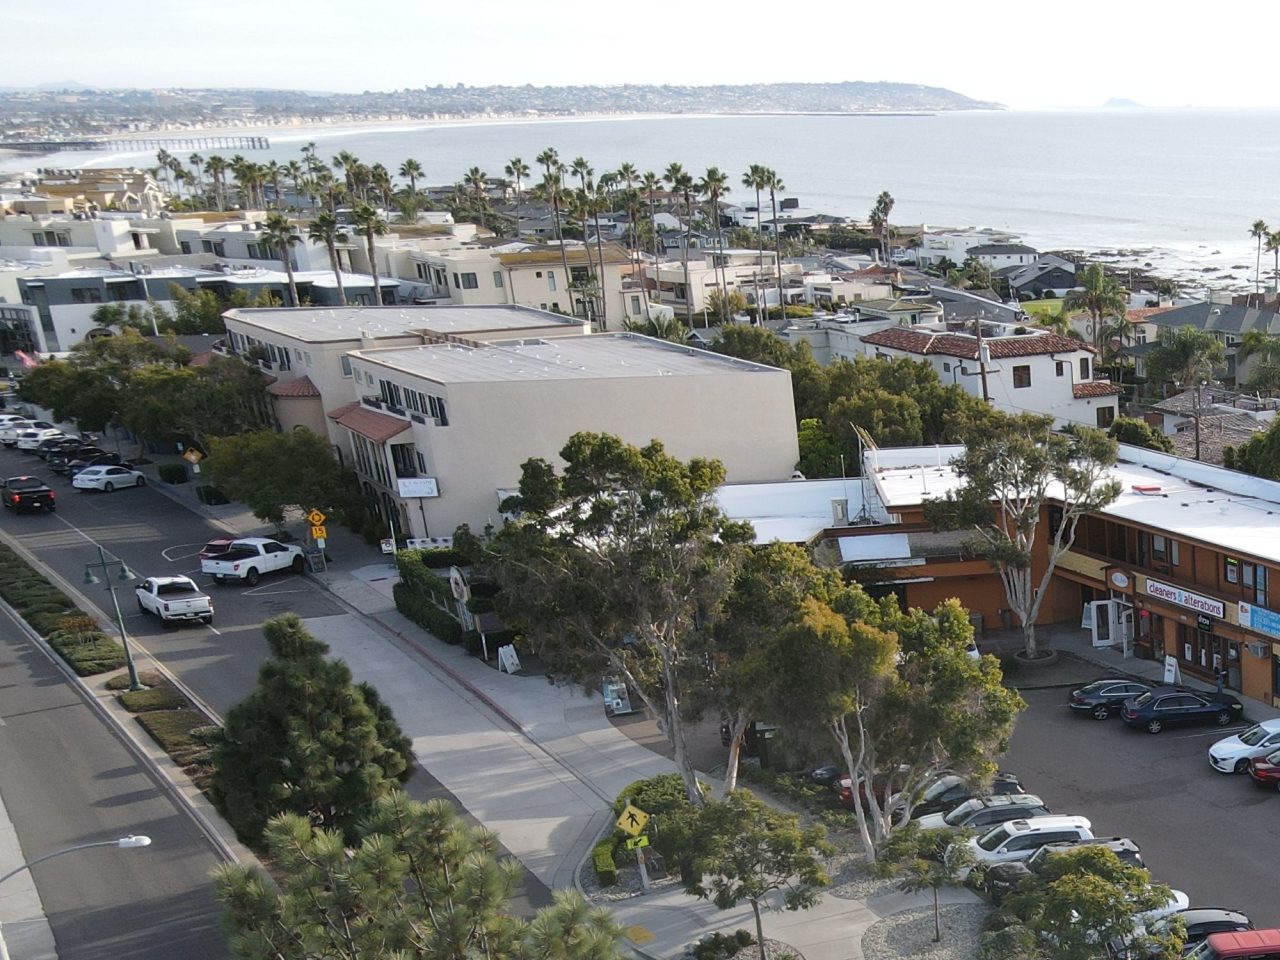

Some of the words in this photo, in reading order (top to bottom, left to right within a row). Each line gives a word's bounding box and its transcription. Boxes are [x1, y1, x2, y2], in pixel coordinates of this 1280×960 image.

[314, 527, 324, 535] 15
[1149, 583, 1177, 601] cleaners
[1184, 594, 1221, 615] alterations
